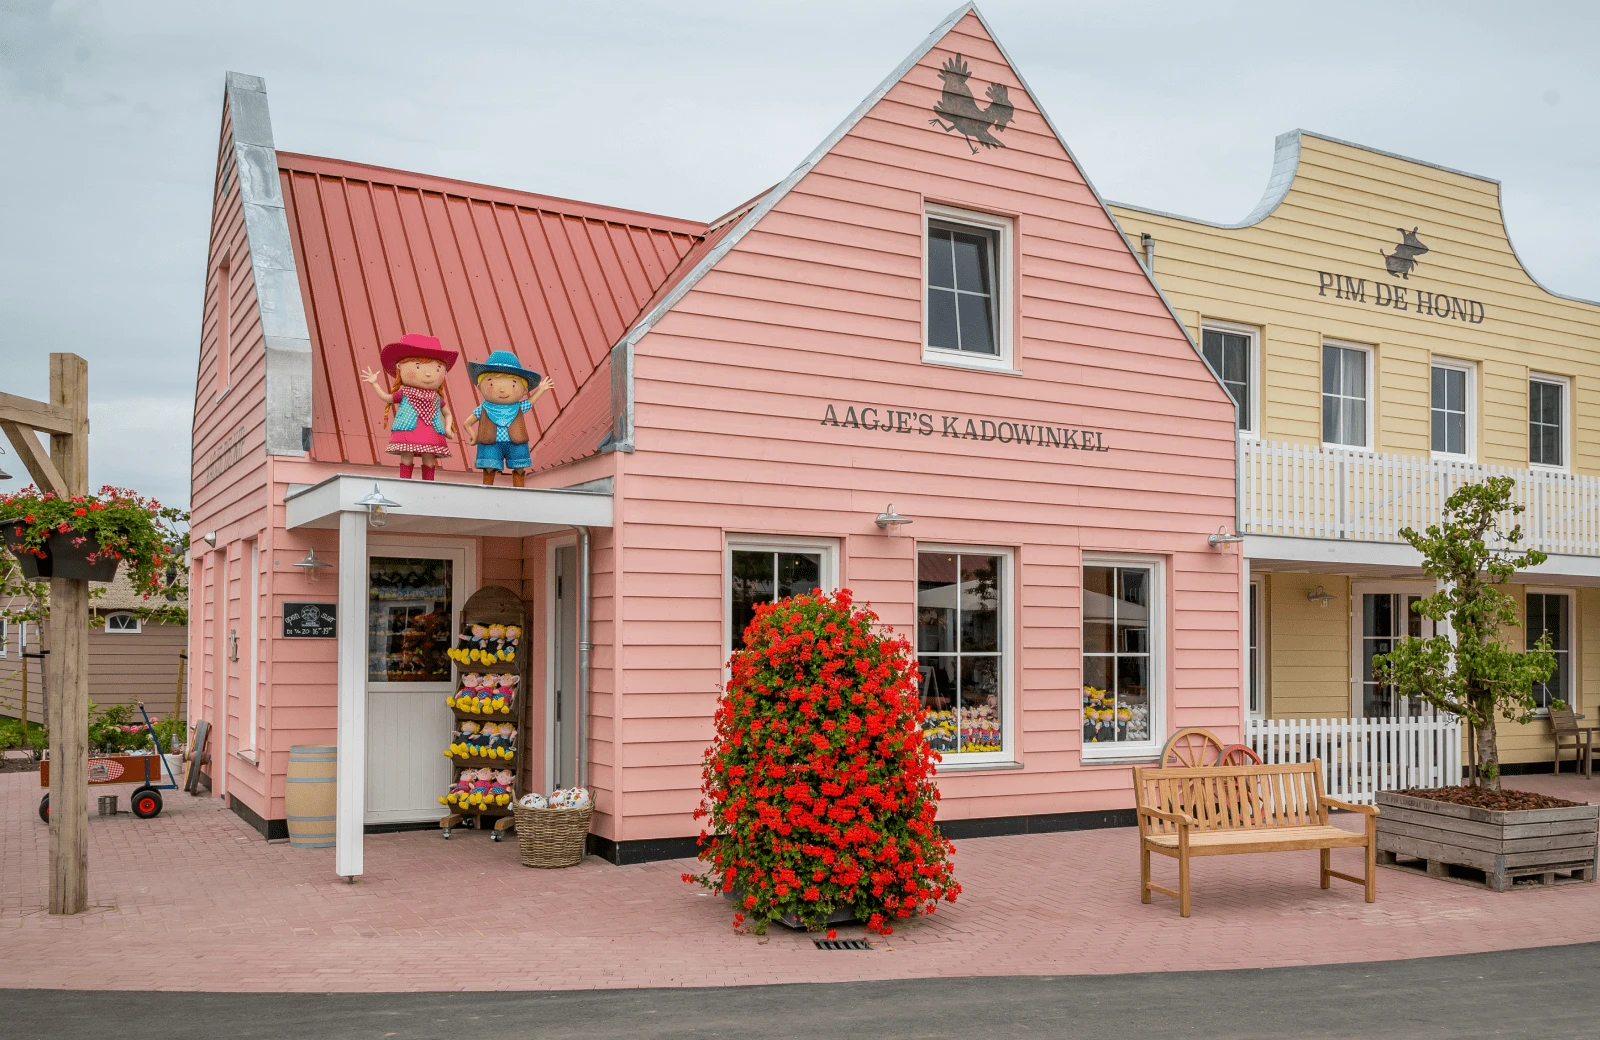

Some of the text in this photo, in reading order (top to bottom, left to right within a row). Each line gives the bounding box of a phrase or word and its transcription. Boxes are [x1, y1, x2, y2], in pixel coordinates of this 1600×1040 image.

[1318, 271, 1485, 324] PIM DE HOND
[820, 403, 1110, 453] AAGJE'S KADOWINKEL
